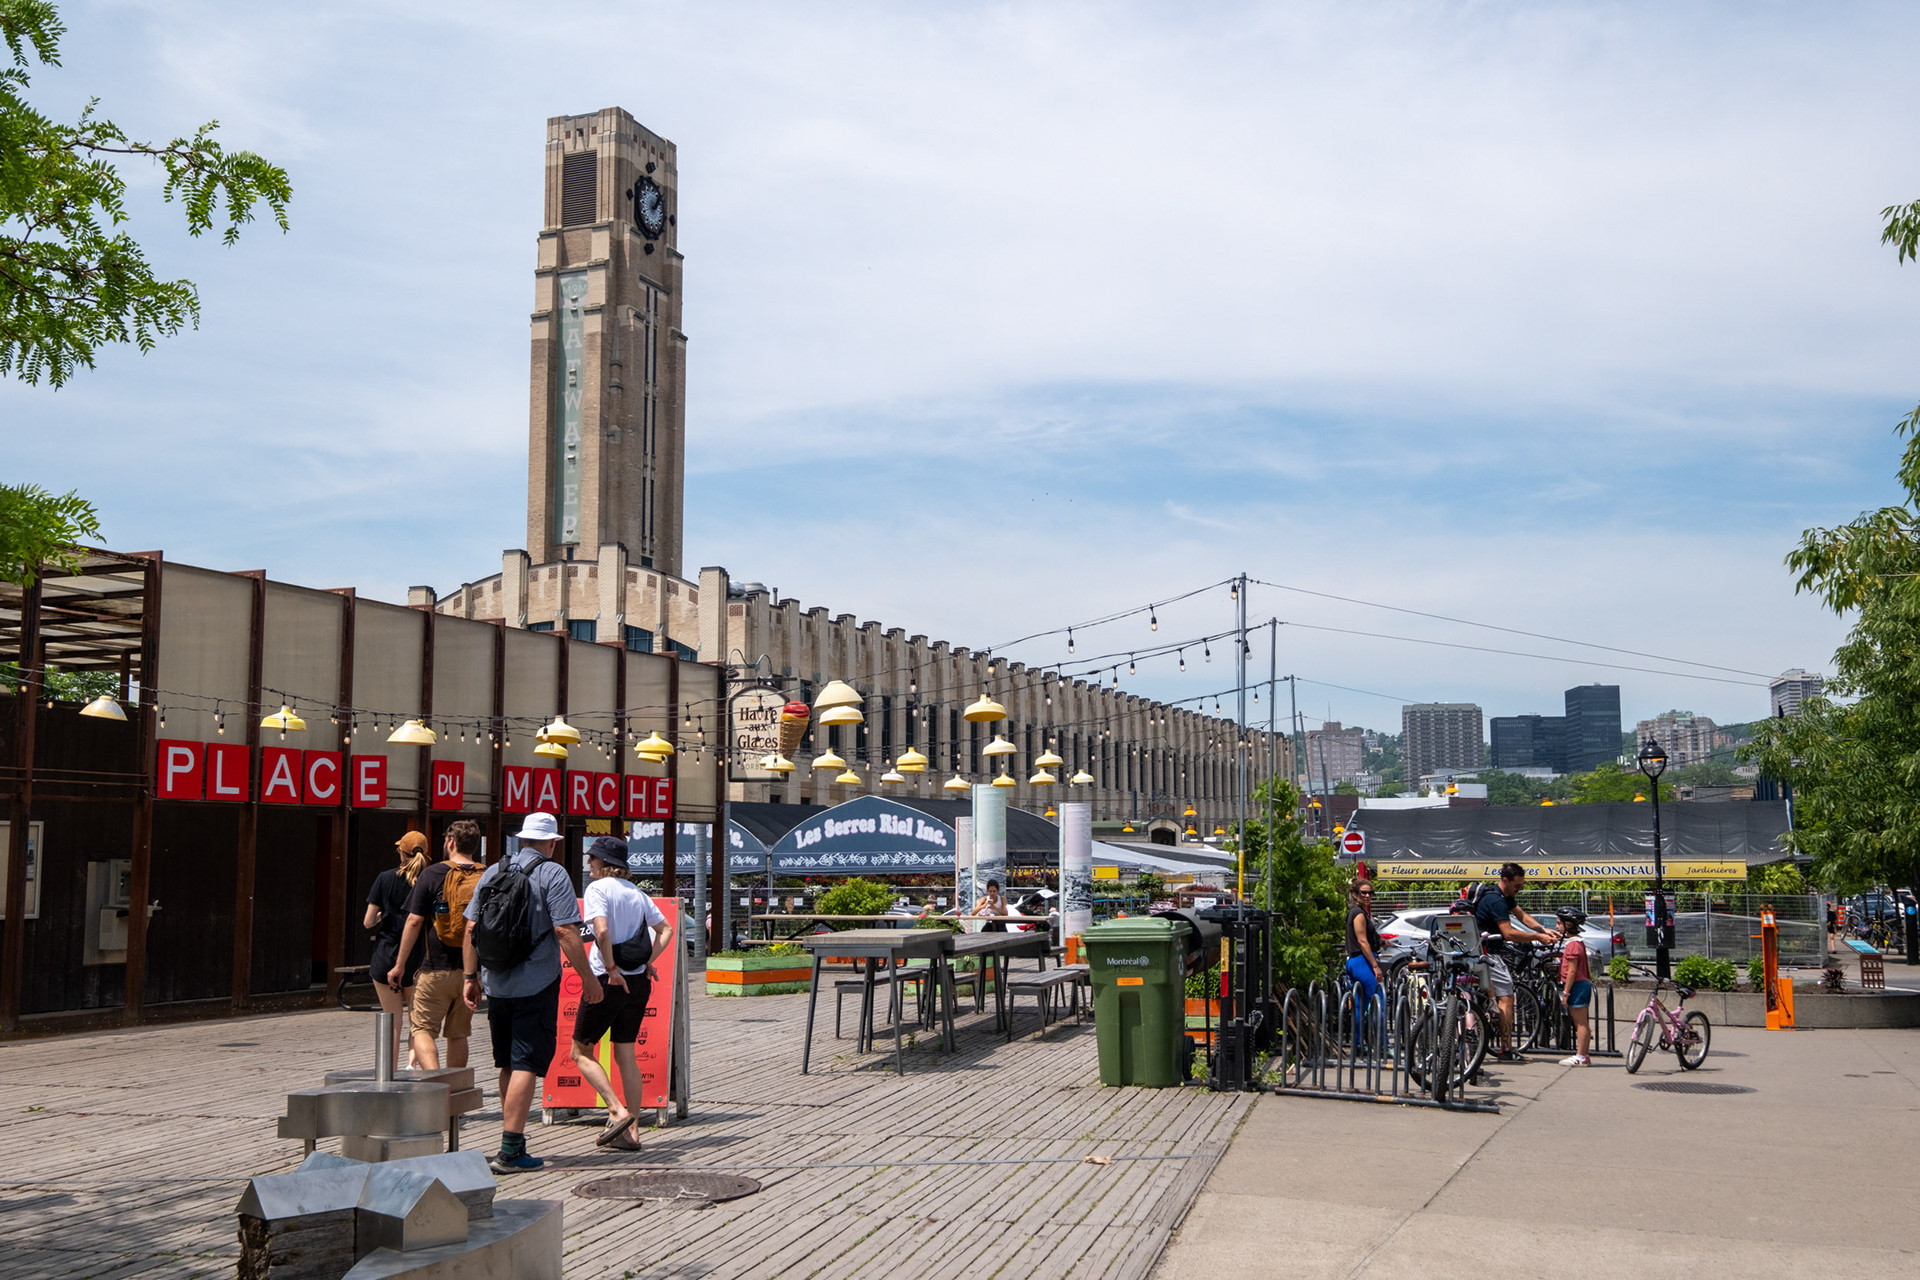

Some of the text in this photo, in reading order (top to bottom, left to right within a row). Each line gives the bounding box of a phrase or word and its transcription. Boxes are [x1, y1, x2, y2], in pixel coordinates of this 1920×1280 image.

[562, 328, 583, 539] ATWATER
[737, 734, 779, 748] Glaces
[166, 746, 670, 814] PLACE DU MARCHÉ
[794, 813, 947, 849] Les Serres Riel Inc.
[1391, 865, 1468, 875] Fleurs annuelles
[1573, 865, 1667, 876] PINSONNEAUT
[1685, 865, 1738, 875] Jardinières
[1106, 957, 1139, 965] Montréal
